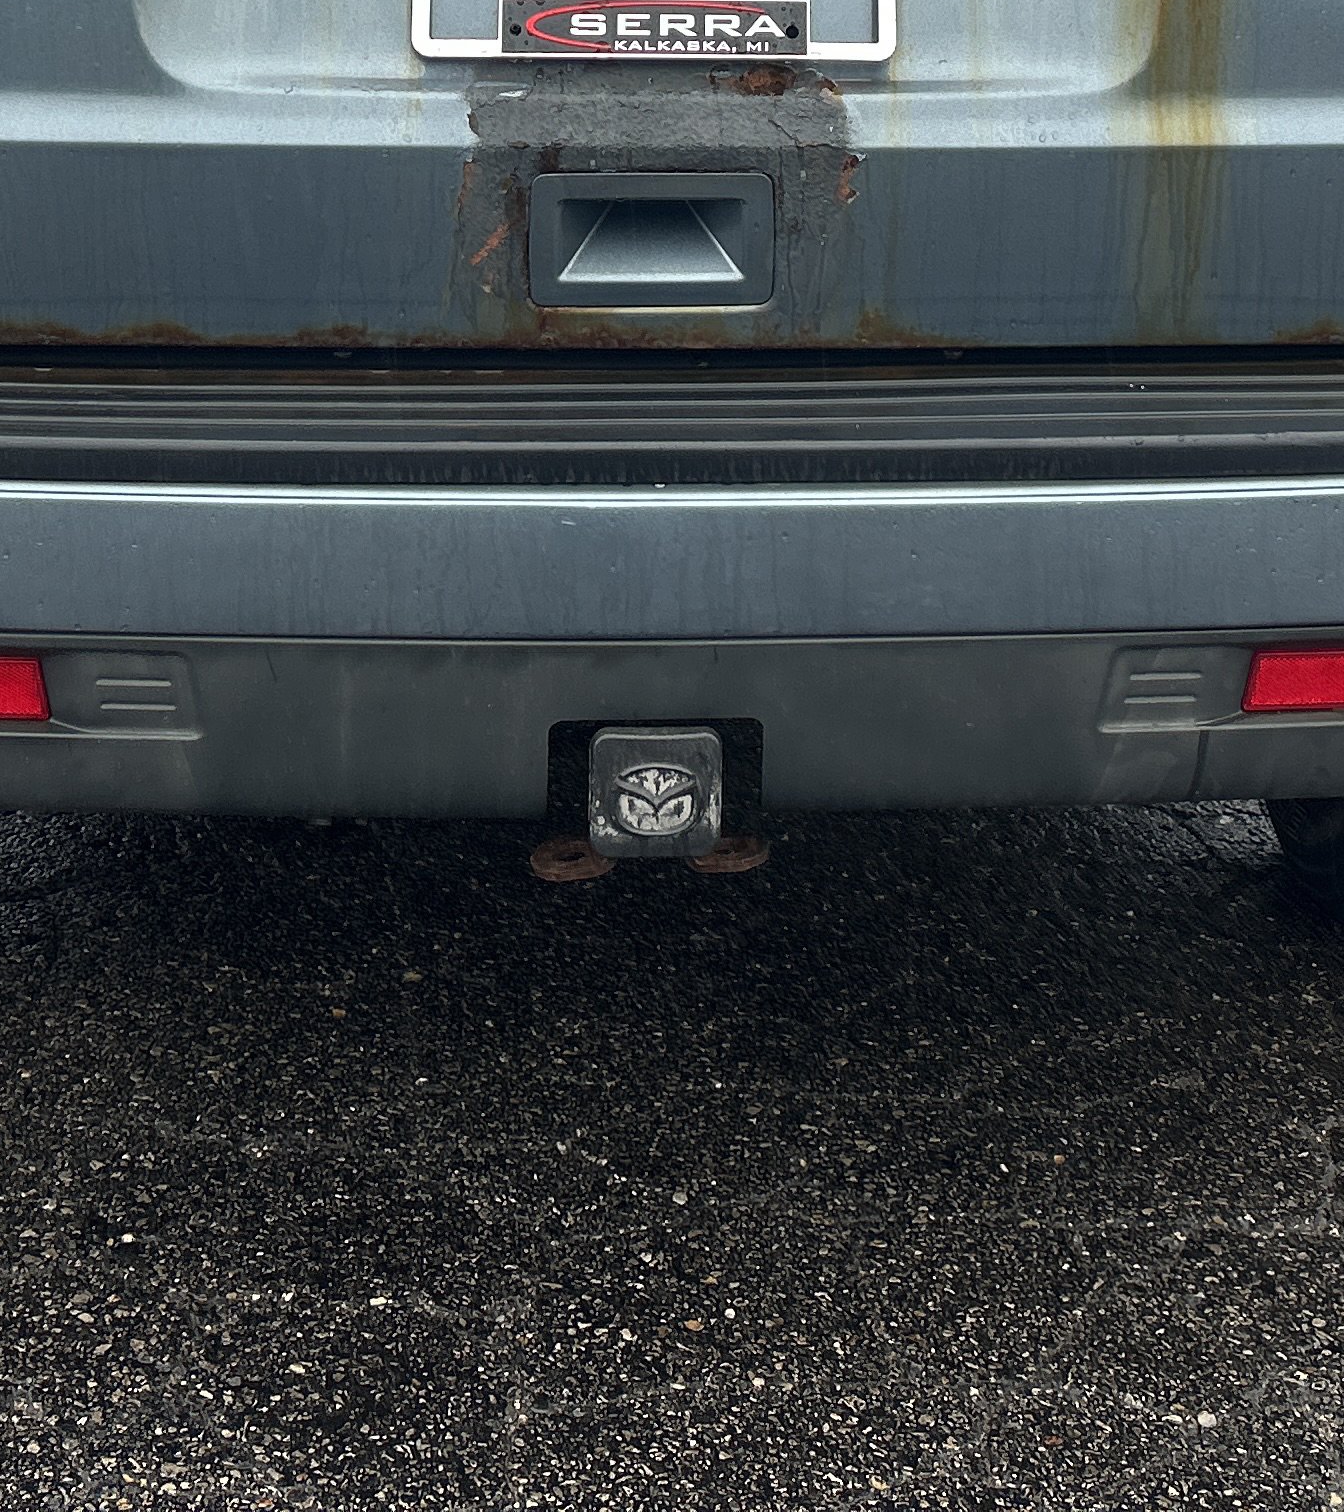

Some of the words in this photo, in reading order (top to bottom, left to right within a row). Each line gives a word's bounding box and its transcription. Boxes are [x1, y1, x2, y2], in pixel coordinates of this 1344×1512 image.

[569, 13, 786, 37] SERRA
[613, 39, 737, 53] KALKASKA,
[747, 40, 769, 52] MI
